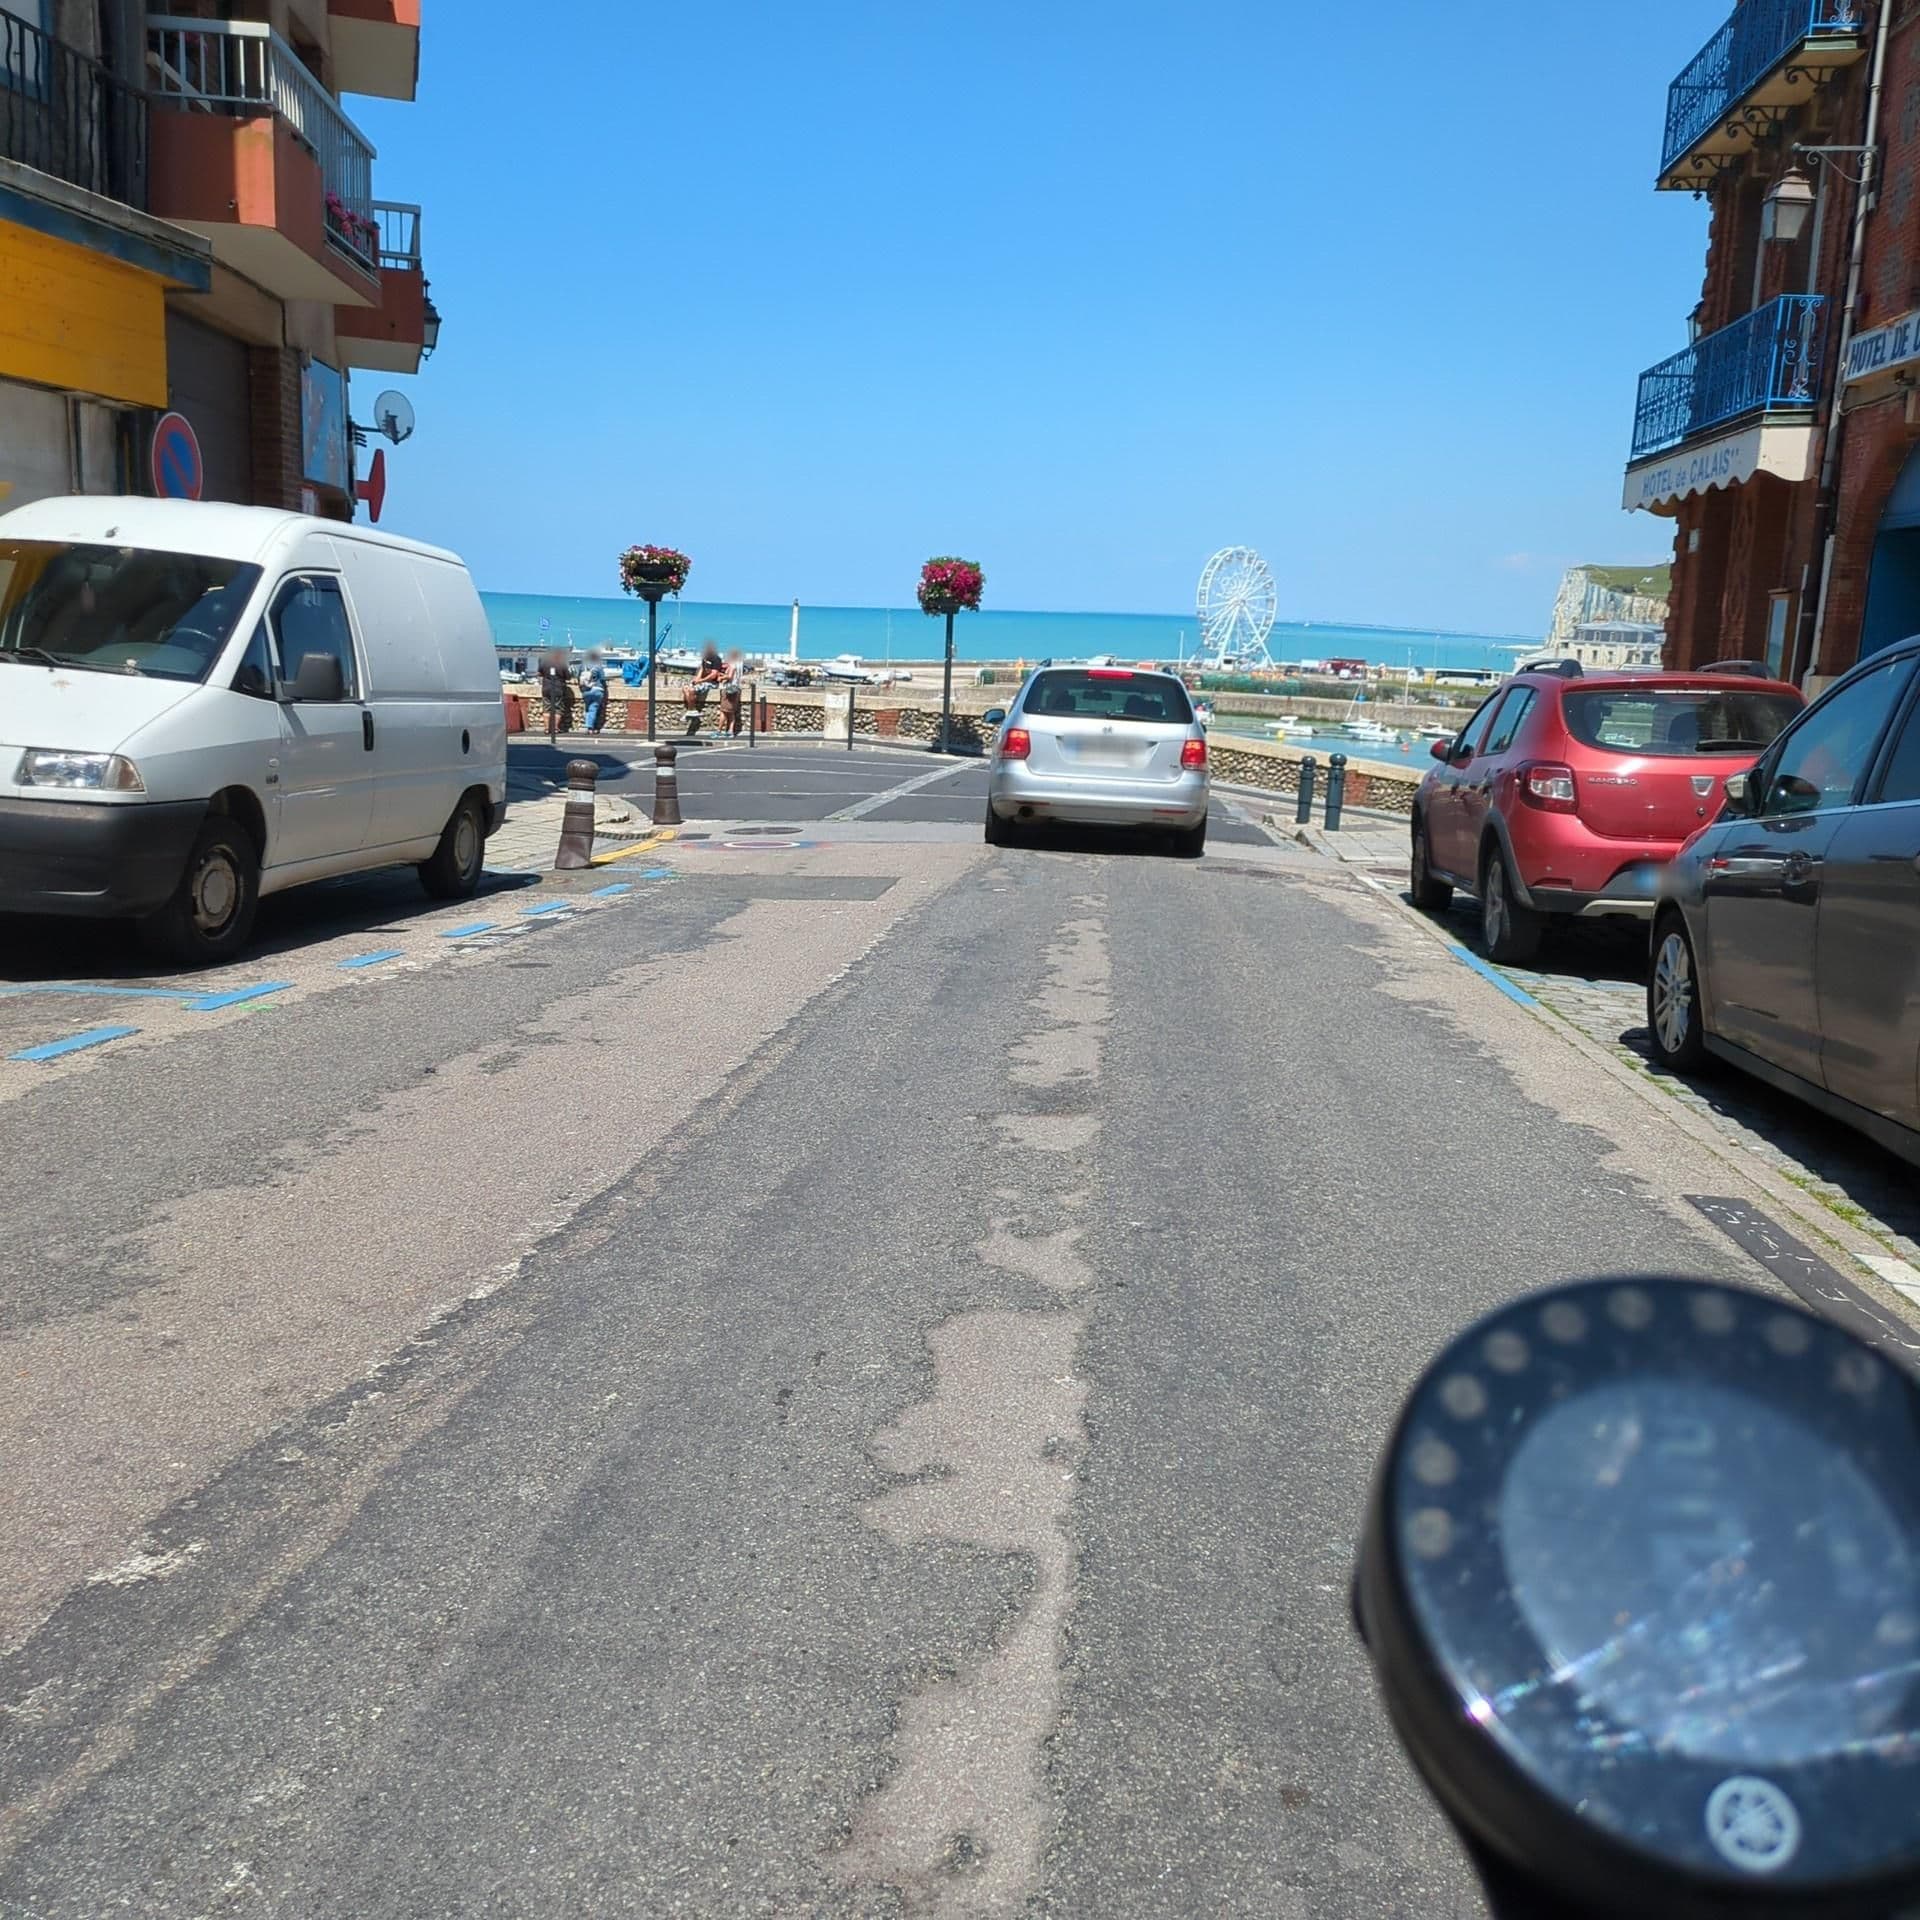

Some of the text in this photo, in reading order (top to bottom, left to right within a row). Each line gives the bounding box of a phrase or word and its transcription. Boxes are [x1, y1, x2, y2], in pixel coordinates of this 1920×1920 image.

[1847, 331, 1887, 377] HOTEL
[1890, 322, 1911, 361] DE
[1642, 467, 1672, 498] HOTEL
